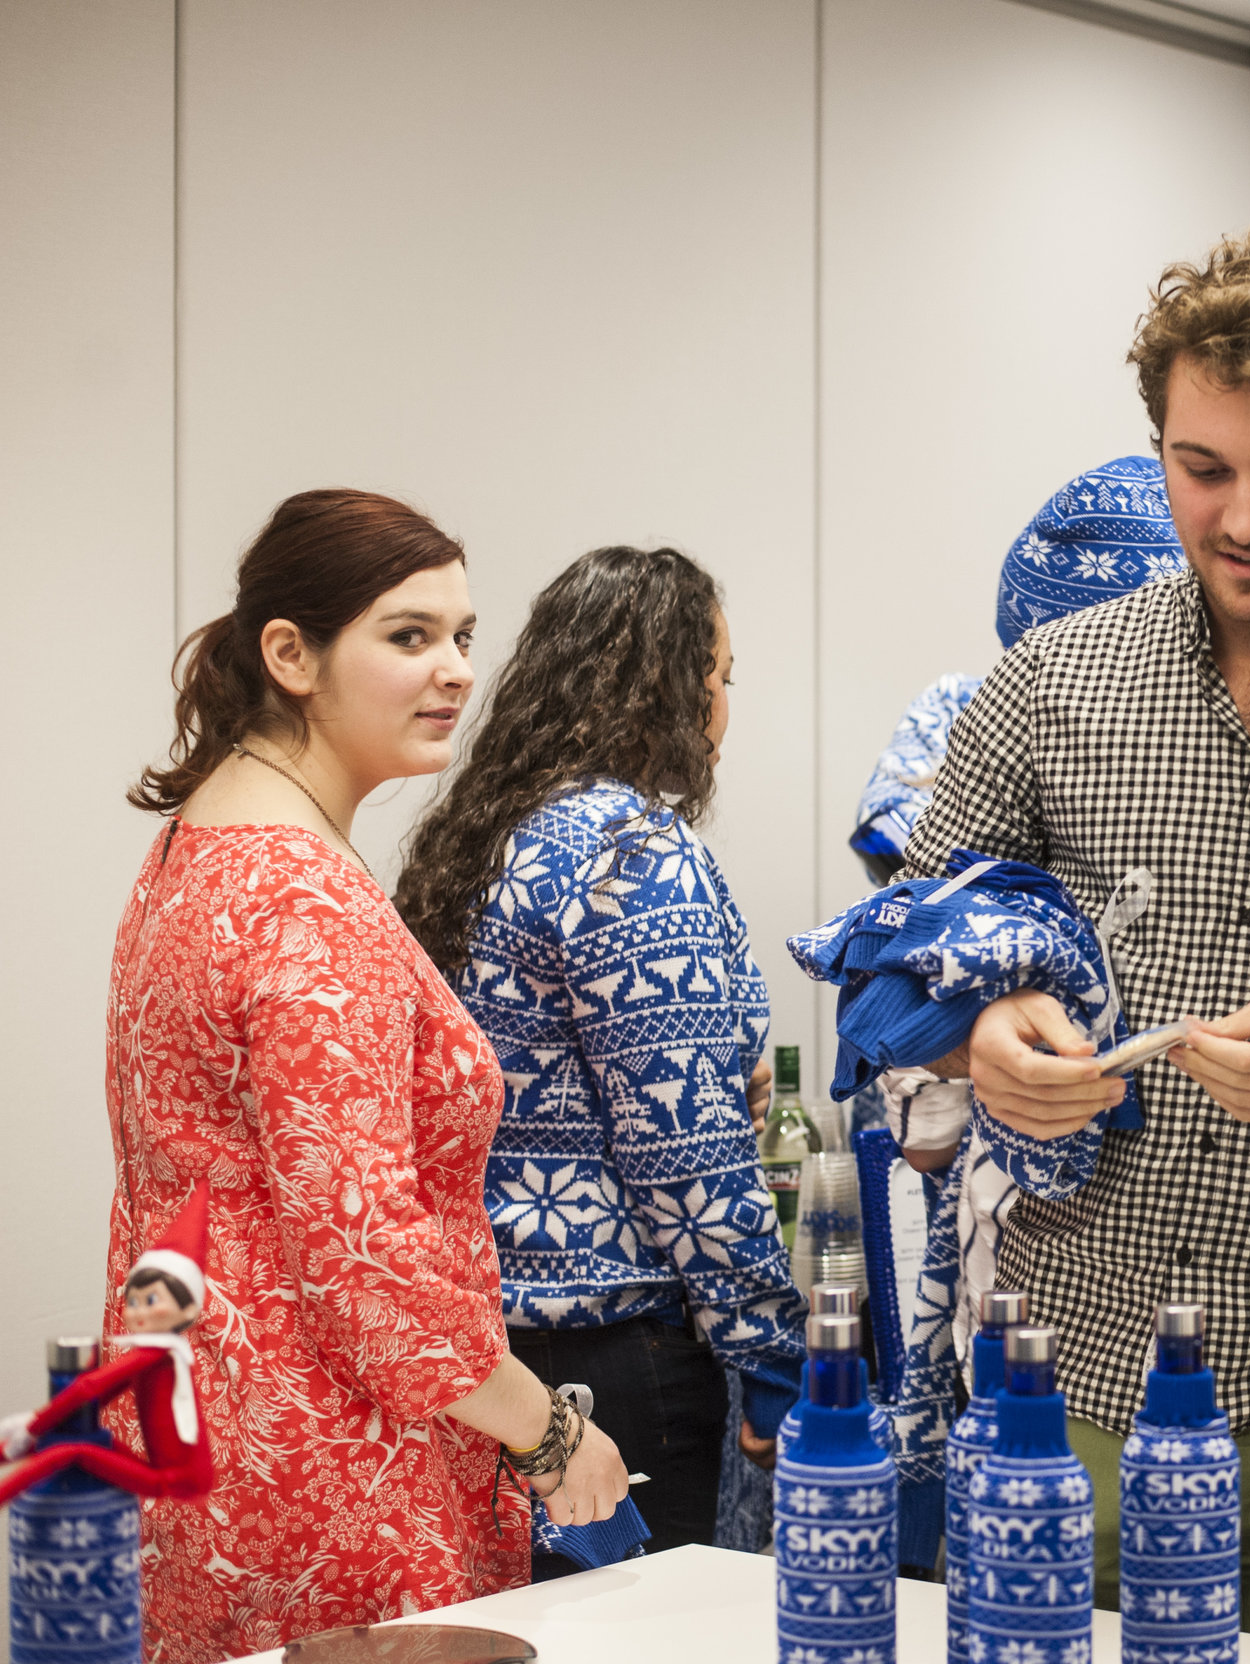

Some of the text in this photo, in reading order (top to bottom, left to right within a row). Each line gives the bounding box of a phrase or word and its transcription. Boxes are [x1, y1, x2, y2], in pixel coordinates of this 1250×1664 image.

[766, 1169, 799, 1185] CINZ
[1145, 1466, 1238, 1495] SKYY
[786, 1525, 887, 1553] SKYY
[785, 1550, 890, 1571] VODKA
